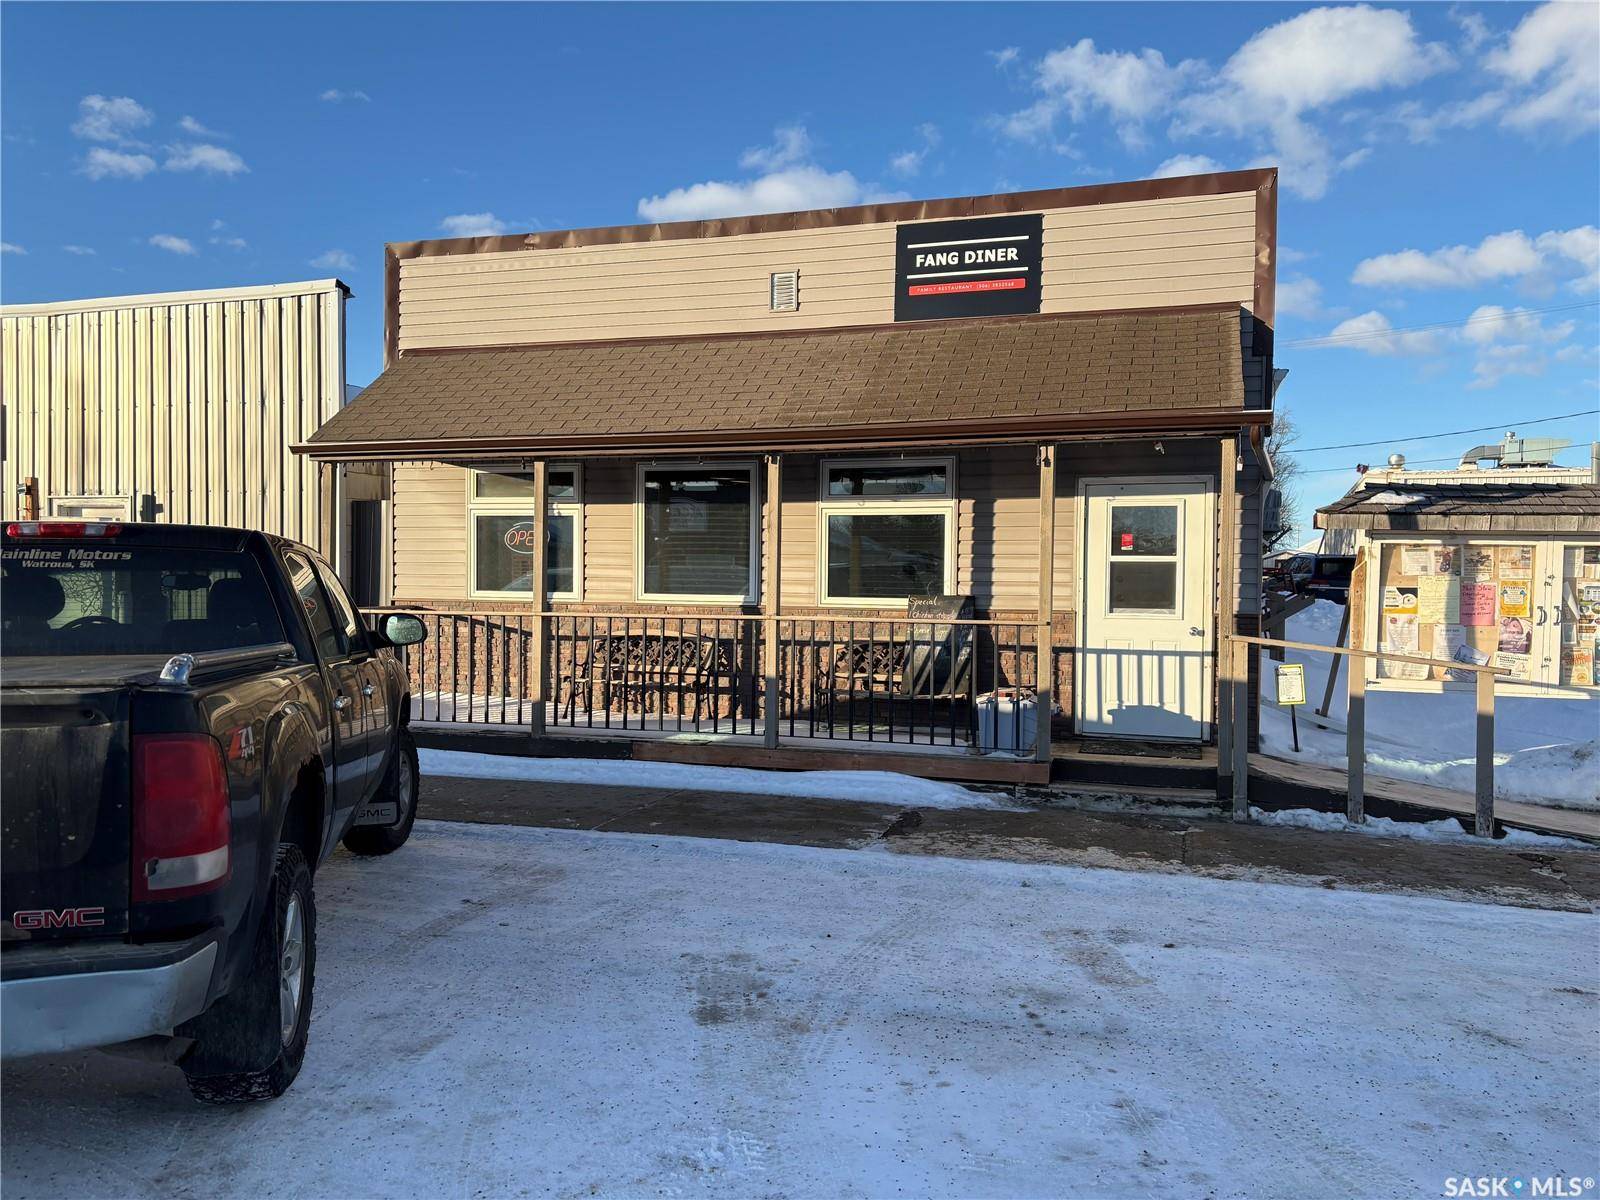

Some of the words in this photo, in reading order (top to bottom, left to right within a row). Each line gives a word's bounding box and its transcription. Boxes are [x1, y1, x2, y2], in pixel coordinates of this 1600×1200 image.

[916, 252, 959, 267] FANG
[964, 248, 1019, 264] DINER
[507, 530, 534, 545] OPE
[0, 549, 62, 559] ainline
[68, 549, 132, 560] Motors
[22, 560, 75, 569] Watrous,
[79, 560, 96, 568] SK
[909, 595, 938, 611] Special
[13, 906, 105, 930] GMC
